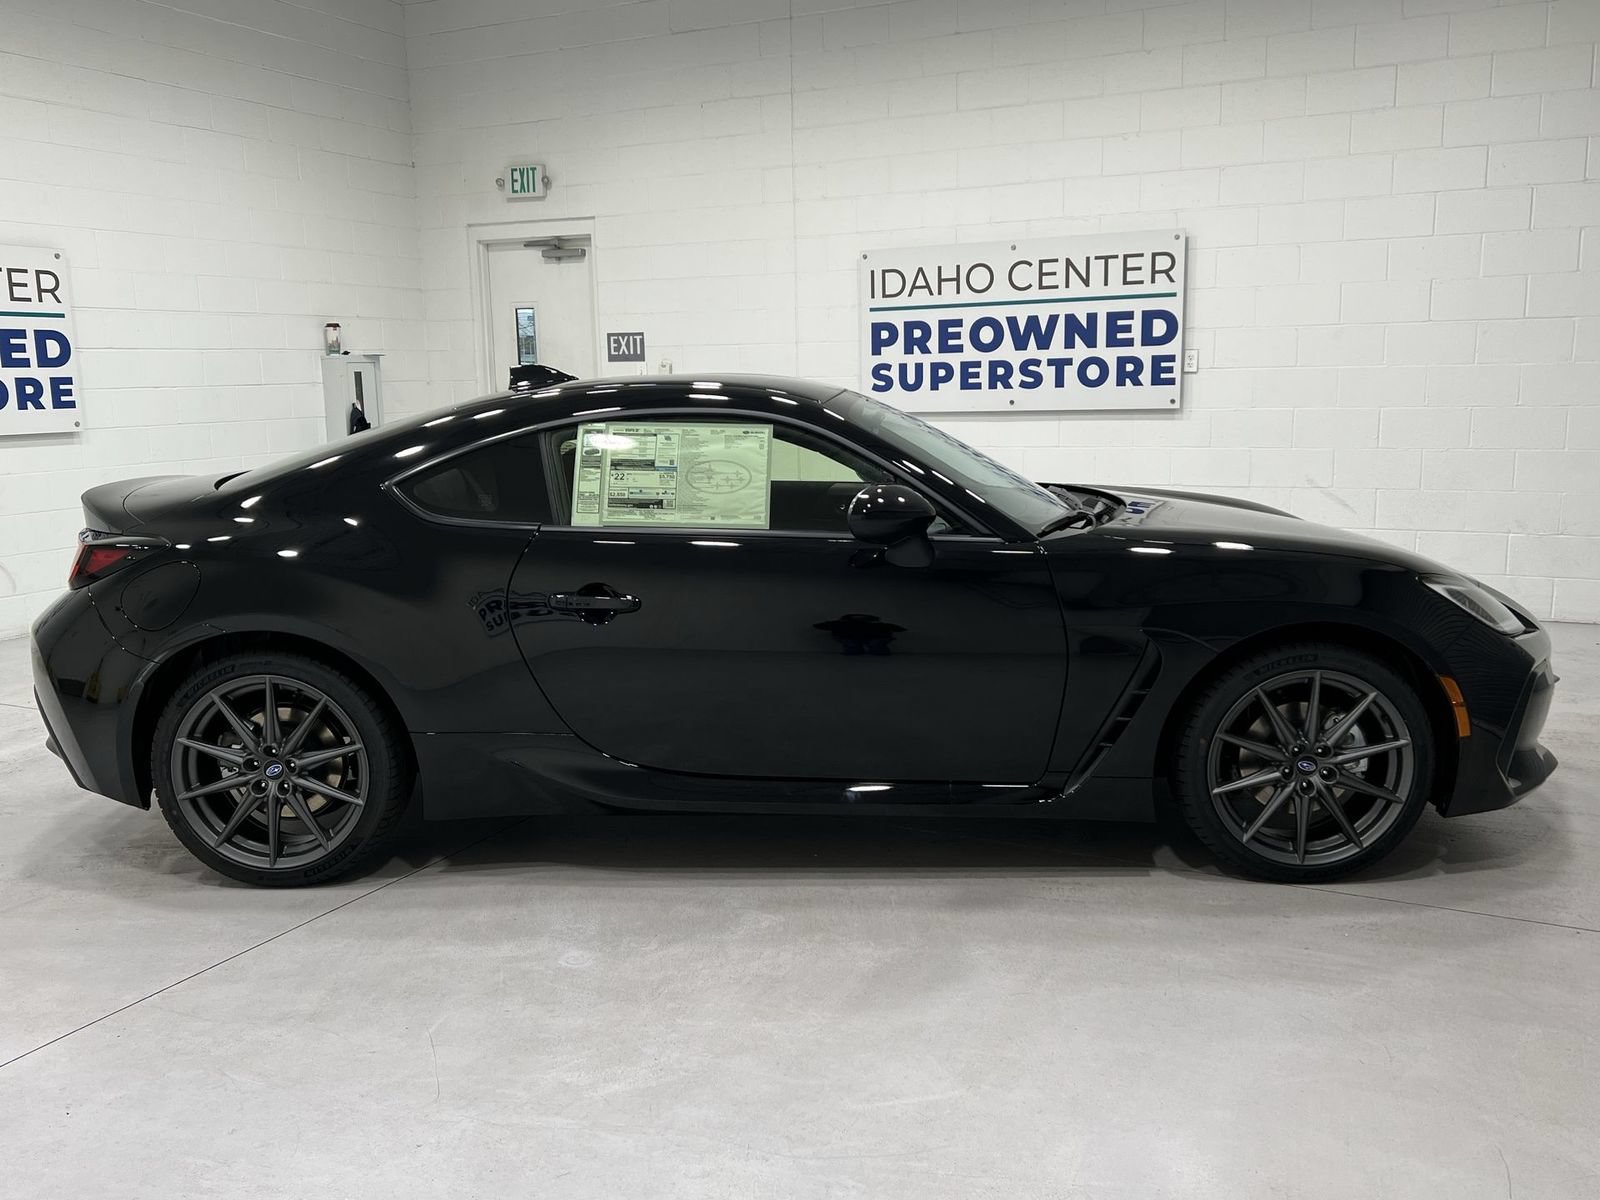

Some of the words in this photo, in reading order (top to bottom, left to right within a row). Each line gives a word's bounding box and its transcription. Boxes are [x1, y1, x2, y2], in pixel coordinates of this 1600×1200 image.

[511, 167, 537, 193] EXIT
[0, 267, 62, 304] ER
[870, 262, 995, 299] IDAHO
[1007, 251, 1177, 291] CENTER
[610, 334, 643, 356] EXIT
[870, 309, 1179, 356] PREOWNED
[871, 354, 1177, 393] SUPERSTORE
[614, 472, 625, 481] 22
